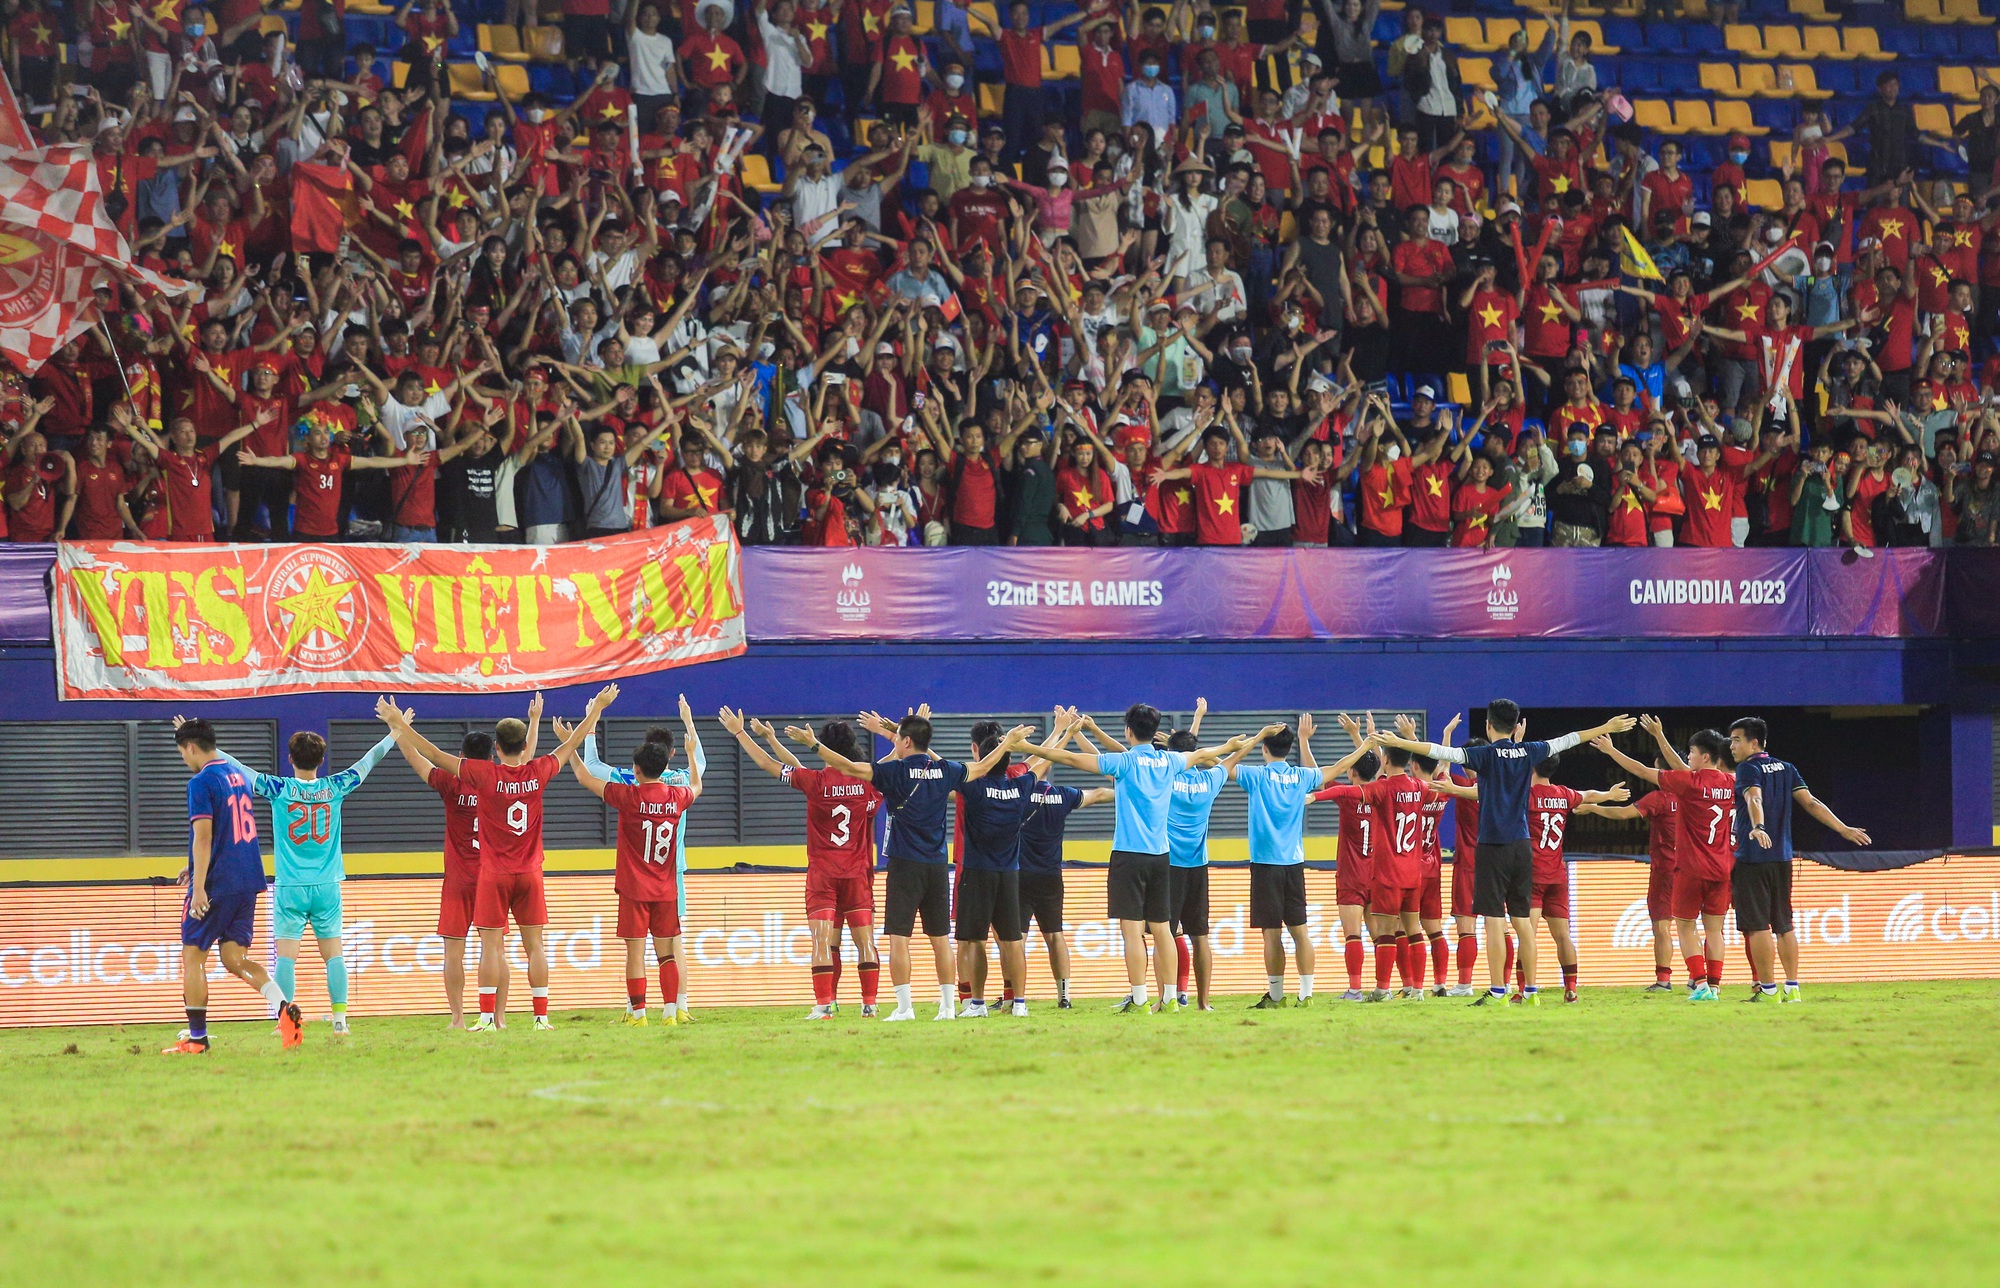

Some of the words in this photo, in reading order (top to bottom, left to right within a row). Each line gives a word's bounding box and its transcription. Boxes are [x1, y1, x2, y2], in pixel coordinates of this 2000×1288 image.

[319, 474, 334, 490] 34
[270, 558, 299, 598] FOOTBALL
[298, 552, 351, 579] SUPPORTERS
[986, 580, 1038, 606] 32nd
[1044, 580, 1084, 607] SEA
[1090, 580, 1163, 606] GAMES
[1629, 579, 1734, 605] CAMBODIA
[1739, 579, 1786, 605] 2023
[374, 555, 552, 675] VIỆT
[569, 541, 738, 648] NAM
[299, 648, 326, 662] SINCE
[505, 781, 520, 794] VAN
[521, 778, 539, 794] TUNG
[832, 785, 845, 797] DUY
[845, 783, 865, 796] CUONG
[1711, 788, 1724, 800] VAN
[227, 793, 257, 845] 16
[287, 801, 331, 846] 20
[506, 800, 528, 837] 9
[648, 803, 663, 814] DUC
[830, 803, 851, 847] 3
[1708, 804, 1723, 845] 7
[641, 819, 675, 865] 18
[1395, 811, 1418, 854] 12
[1539, 811, 1565, 851] 15
